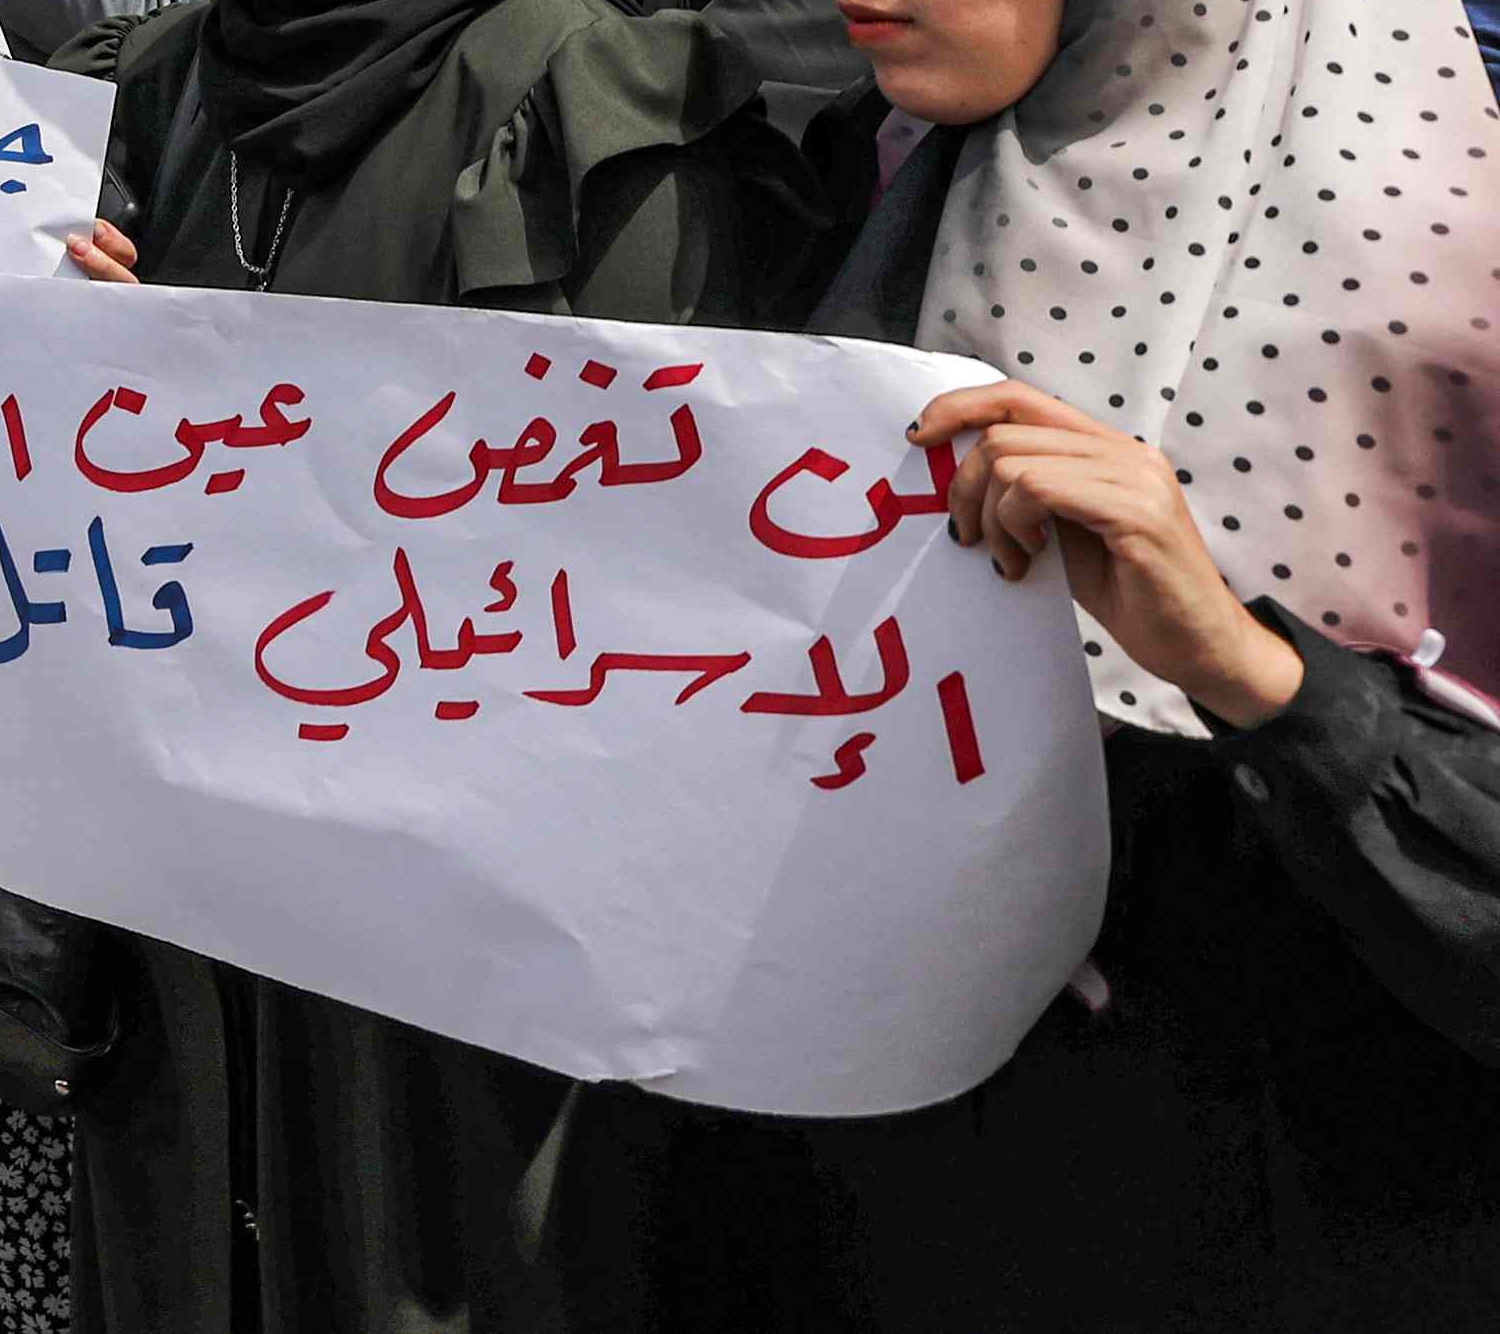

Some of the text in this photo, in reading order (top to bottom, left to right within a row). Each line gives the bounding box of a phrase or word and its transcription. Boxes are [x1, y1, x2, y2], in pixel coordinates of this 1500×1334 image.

[72, 379, 314, 498] عين
[371, 348, 704, 521] تغمض
[253, 545, 986, 791] الإسرائيلي
